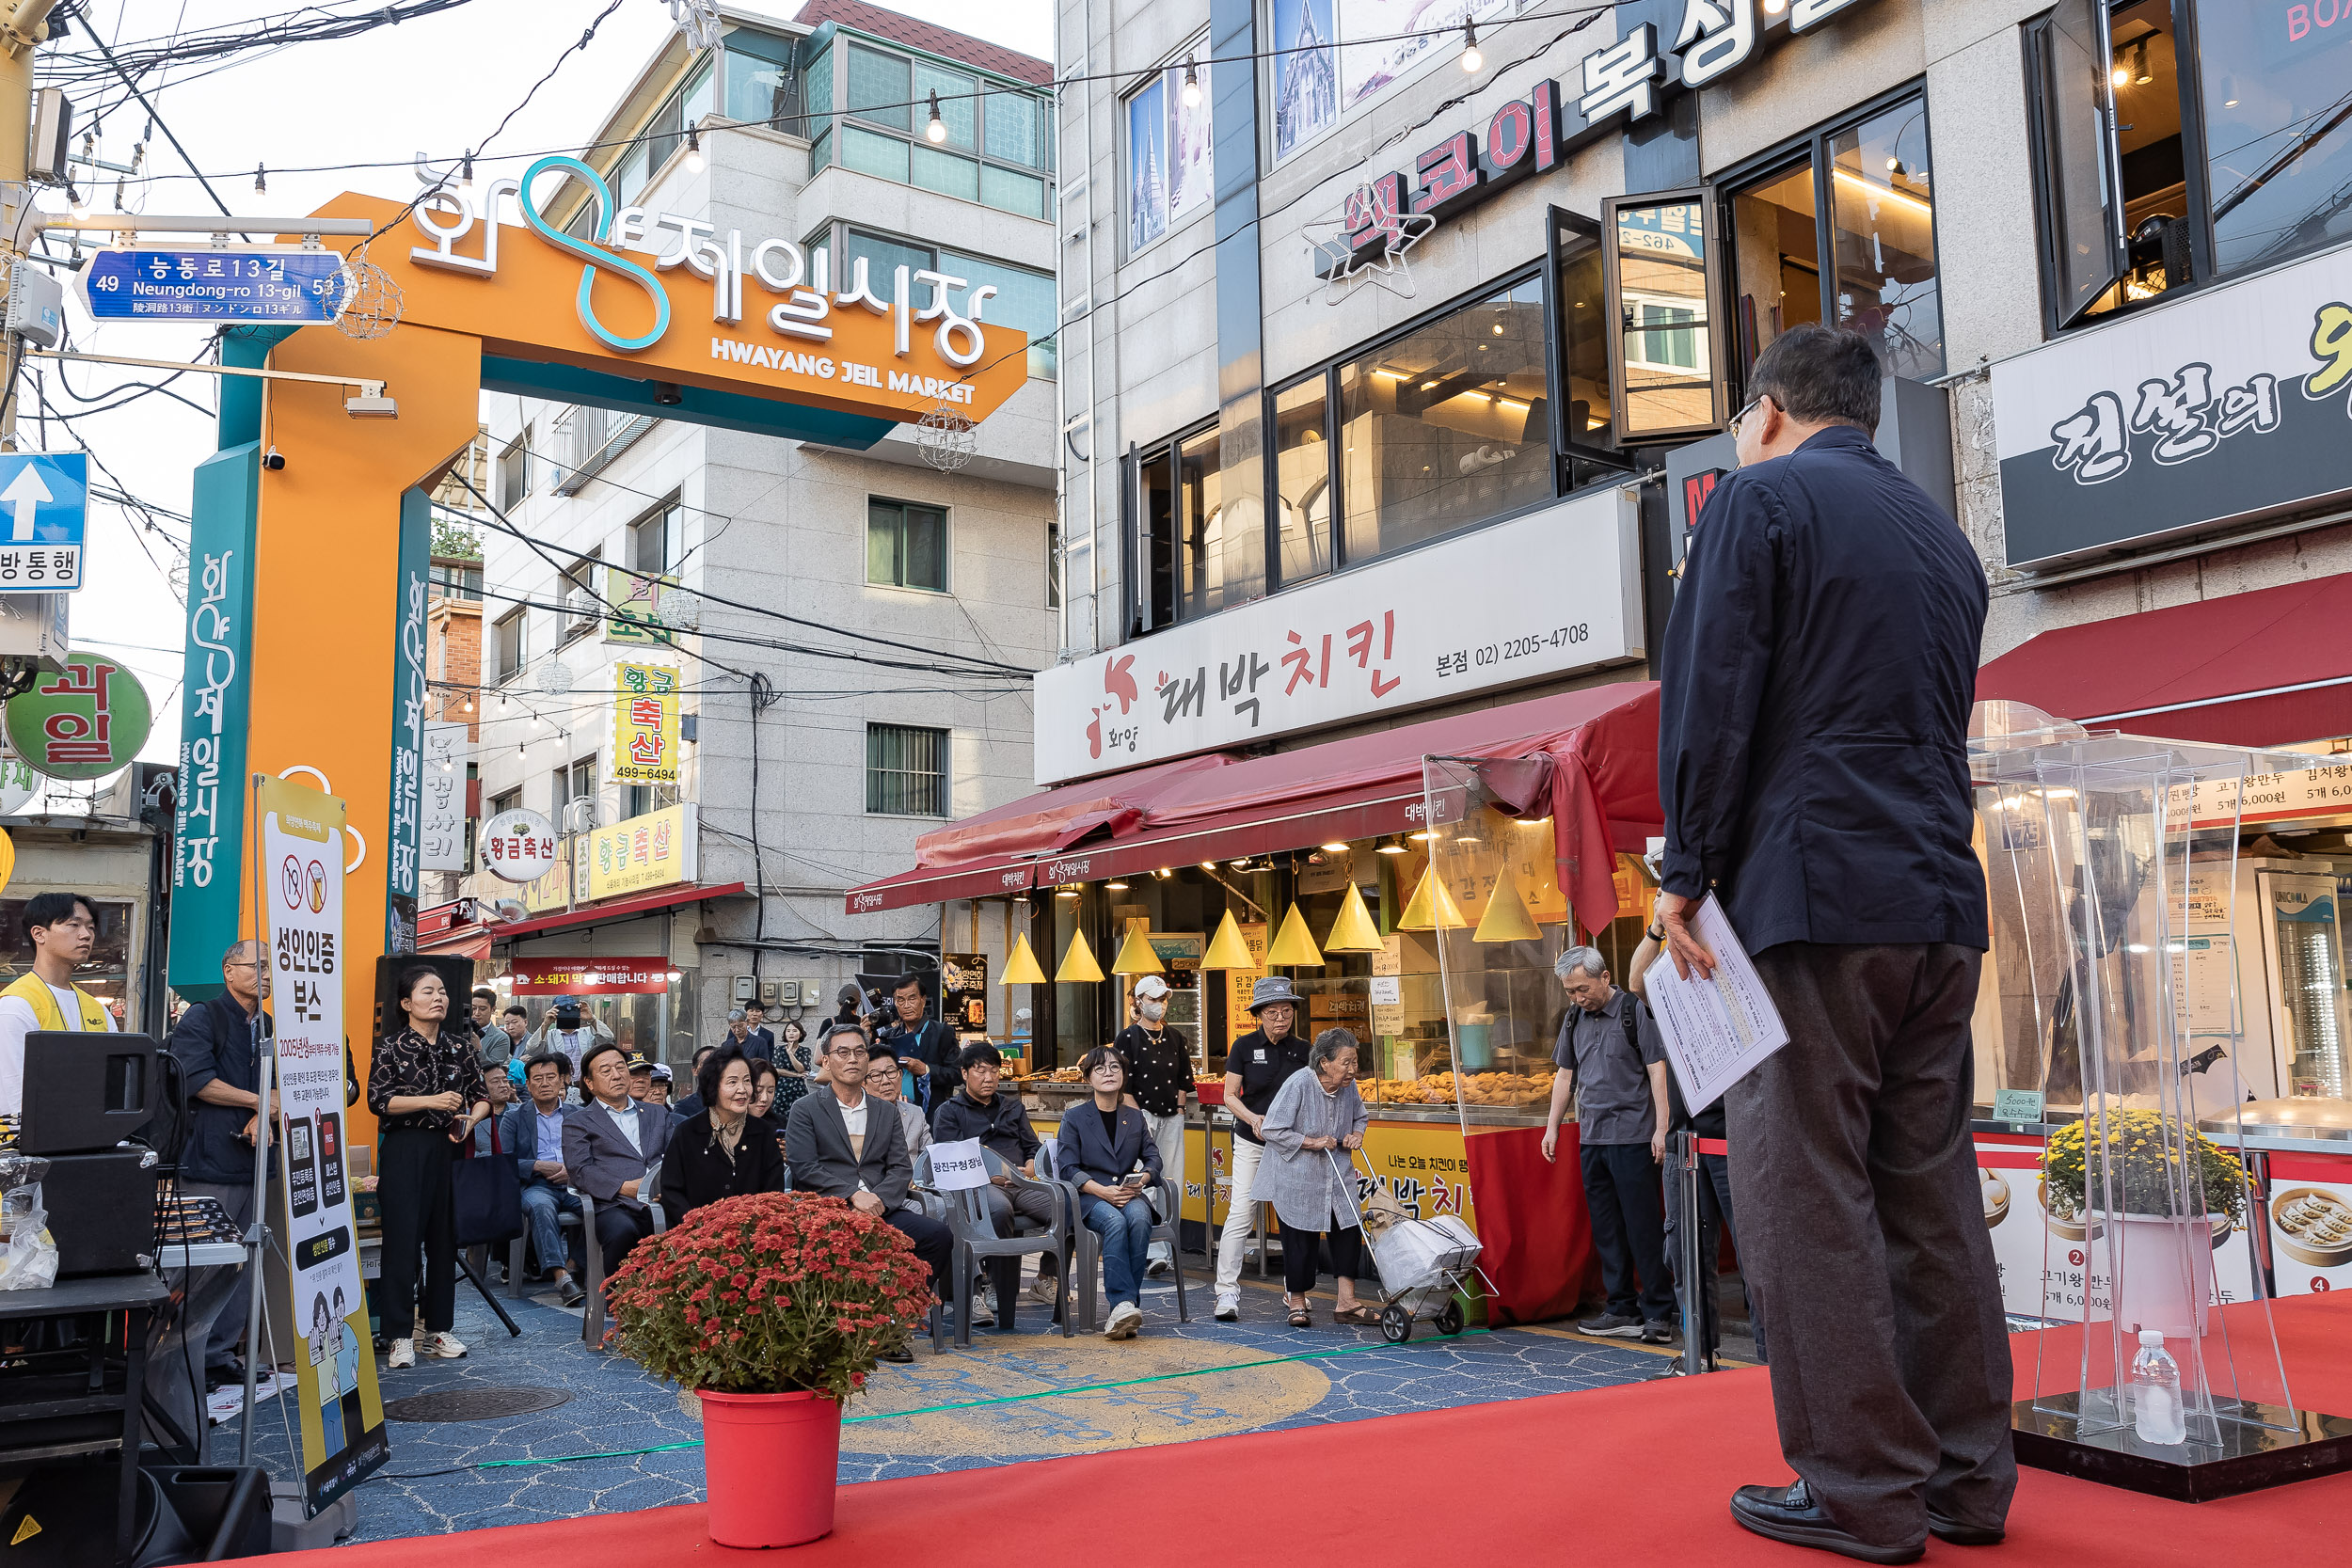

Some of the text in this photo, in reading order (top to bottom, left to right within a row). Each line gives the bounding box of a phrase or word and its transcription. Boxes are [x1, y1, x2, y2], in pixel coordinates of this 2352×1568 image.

[95, 276, 119, 293] 49
[133, 281, 301, 299] Neungdong-ro 13-gil
[711, 337, 976, 405] HWAYANG JEIL MARKET
[2053, 362, 2280, 485] 전설의
[1436, 623, 1590, 679] 본점 02) 2205-4708
[623, 666, 675, 695] 황금
[1155, 610, 1401, 727] 대박치킨
[40, 664, 116, 764] 과일
[629, 697, 666, 766] 축산
[1108, 725, 1139, 752] 화양
[177, 741, 190, 808] HWAYANG
[616, 766, 676, 781] 499-6494
[2241, 791, 2287, 806] 6,000원
[2307, 786, 2328, 800] 5개
[176, 810, 188, 834] JEIL
[490, 836, 555, 861] 황금축산
[598, 819, 672, 875] 황금축산
[174, 836, 186, 888] MARKET
[1002, 870, 1025, 887] 대박치킨
[277, 927, 335, 974] 성인인증
[597, 972, 648, 985] 판매합니다
[294, 979, 322, 1023] 부스
[2005, 1093, 2036, 1107] 5000원
[1388, 1154, 1406, 1168] 나는
[1408, 1156, 1426, 1170] 오늘
[1429, 1157, 1456, 1172] 치킨이
[325, 1179, 341, 1196] 성인인증
